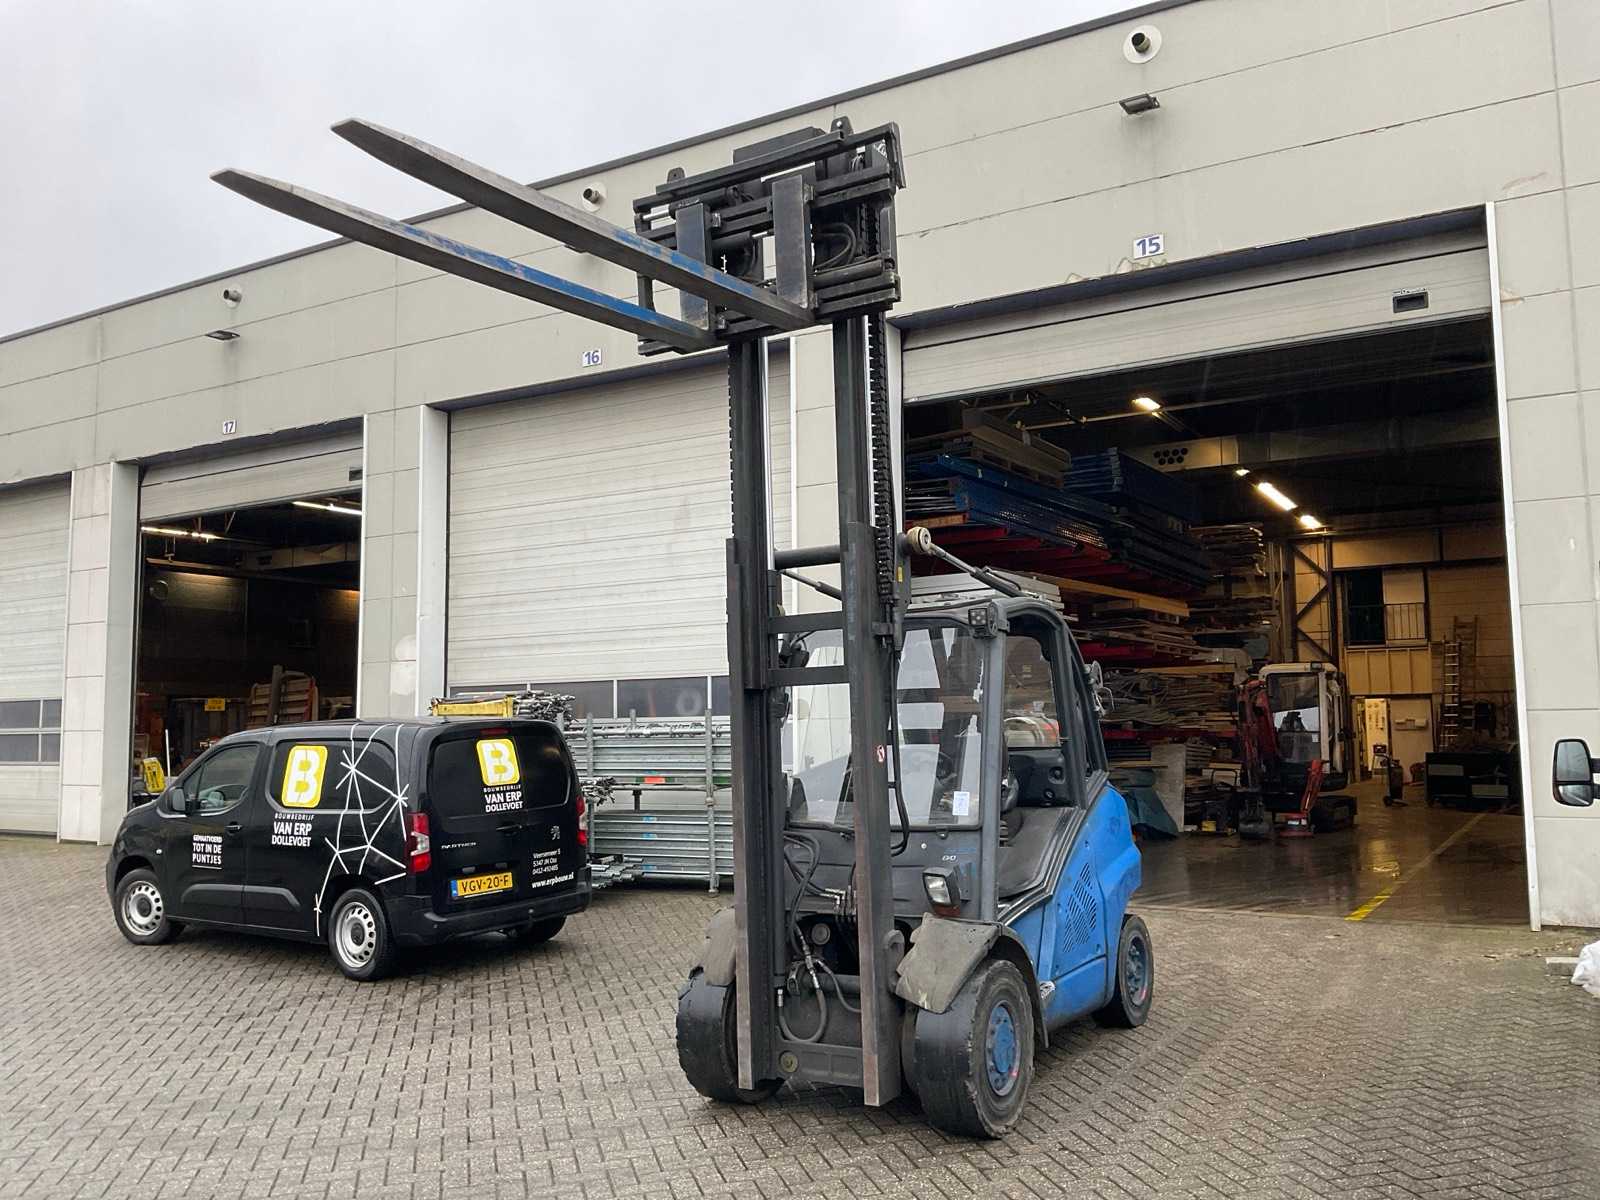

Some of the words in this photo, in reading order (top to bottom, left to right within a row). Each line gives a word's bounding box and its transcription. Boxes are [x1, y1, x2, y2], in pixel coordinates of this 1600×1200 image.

[1136, 236, 1161, 257] 15
[584, 350, 600, 365] 16
[224, 421, 235, 433] 17
[482, 742, 516, 785] B
[286, 748, 321, 803] B
[484, 792, 504, 804] VAN
[505, 790, 522, 803] ERP
[485, 800, 524, 813] DOLLEVOET
[273, 821, 293, 835] VAN
[293, 822, 313, 836] ERP
[271, 834, 312, 848] DOLLEVOET
[192, 842, 205, 853] TOT
[205, 843, 213, 854] IN
[213, 844, 223, 855] DE
[192, 853, 222, 865] PUNTJES
[461, 874, 510, 893] VGV-20-F
